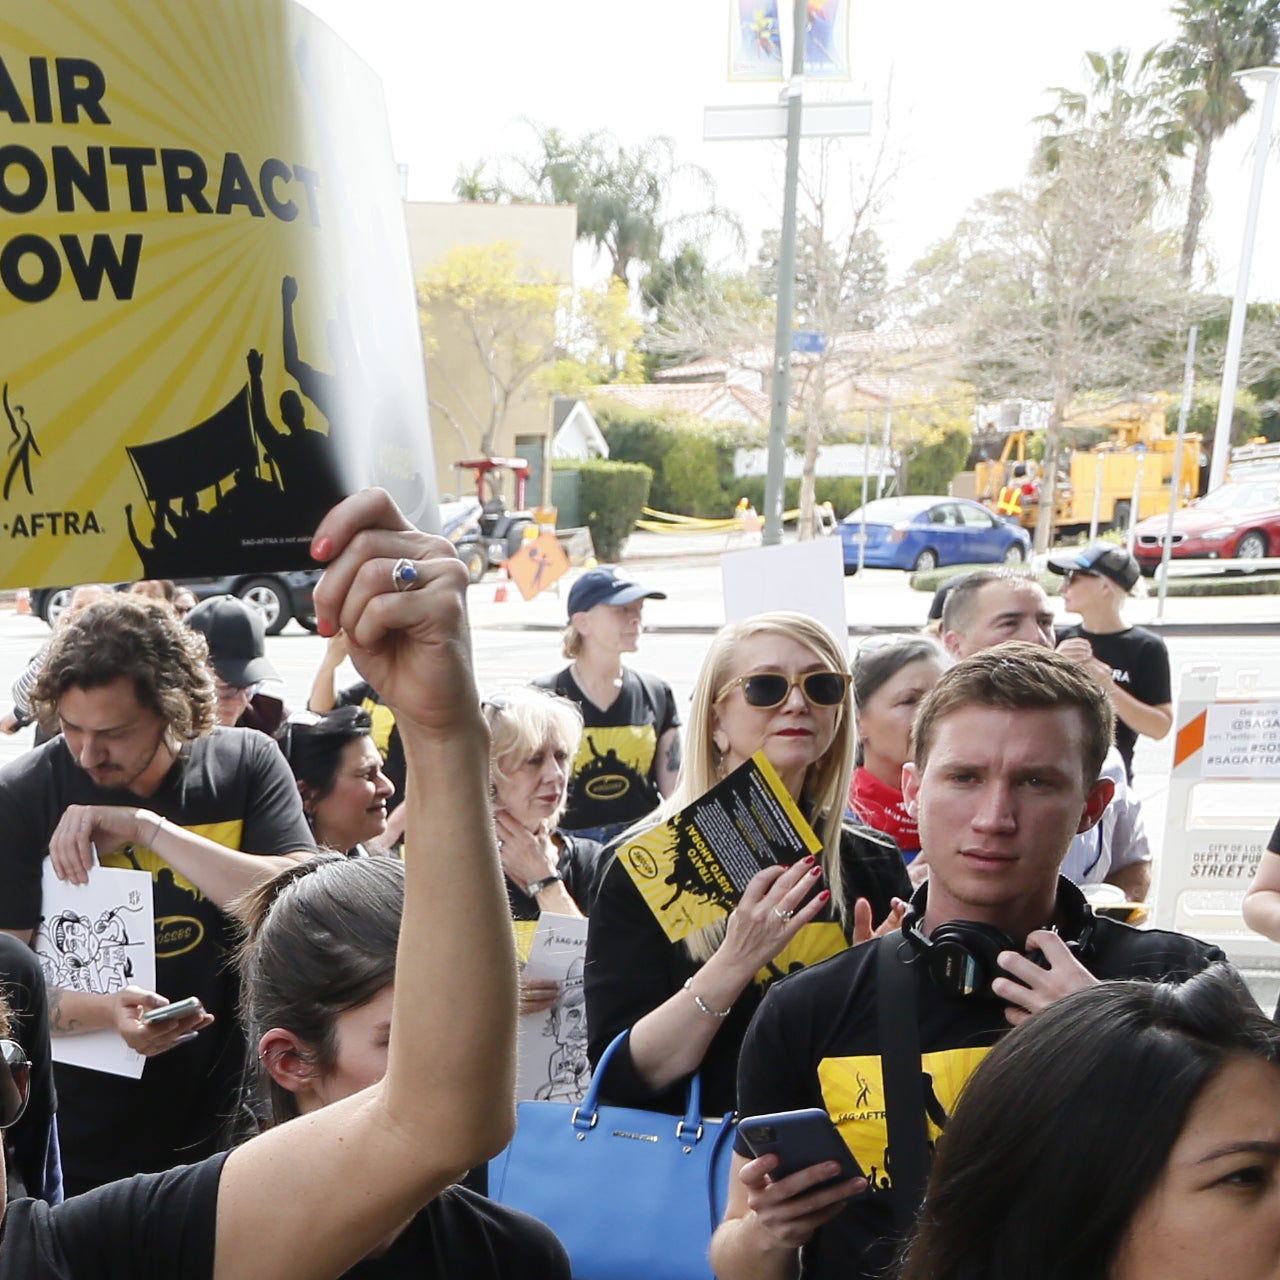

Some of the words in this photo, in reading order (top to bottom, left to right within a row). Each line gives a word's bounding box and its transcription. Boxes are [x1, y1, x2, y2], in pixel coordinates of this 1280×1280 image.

[1231, 719, 1280, 730] @SAGA
[1208, 843, 1228, 852] CITY
[1230, 844, 1241, 852] OF
[1244, 844, 1262, 852] LOS
[1193, 852, 1220, 862] DEPT.
[1225, 853, 1239, 862] OF
[1241, 853, 1262, 862] PUB
[1190, 864, 1245, 878] STREET
